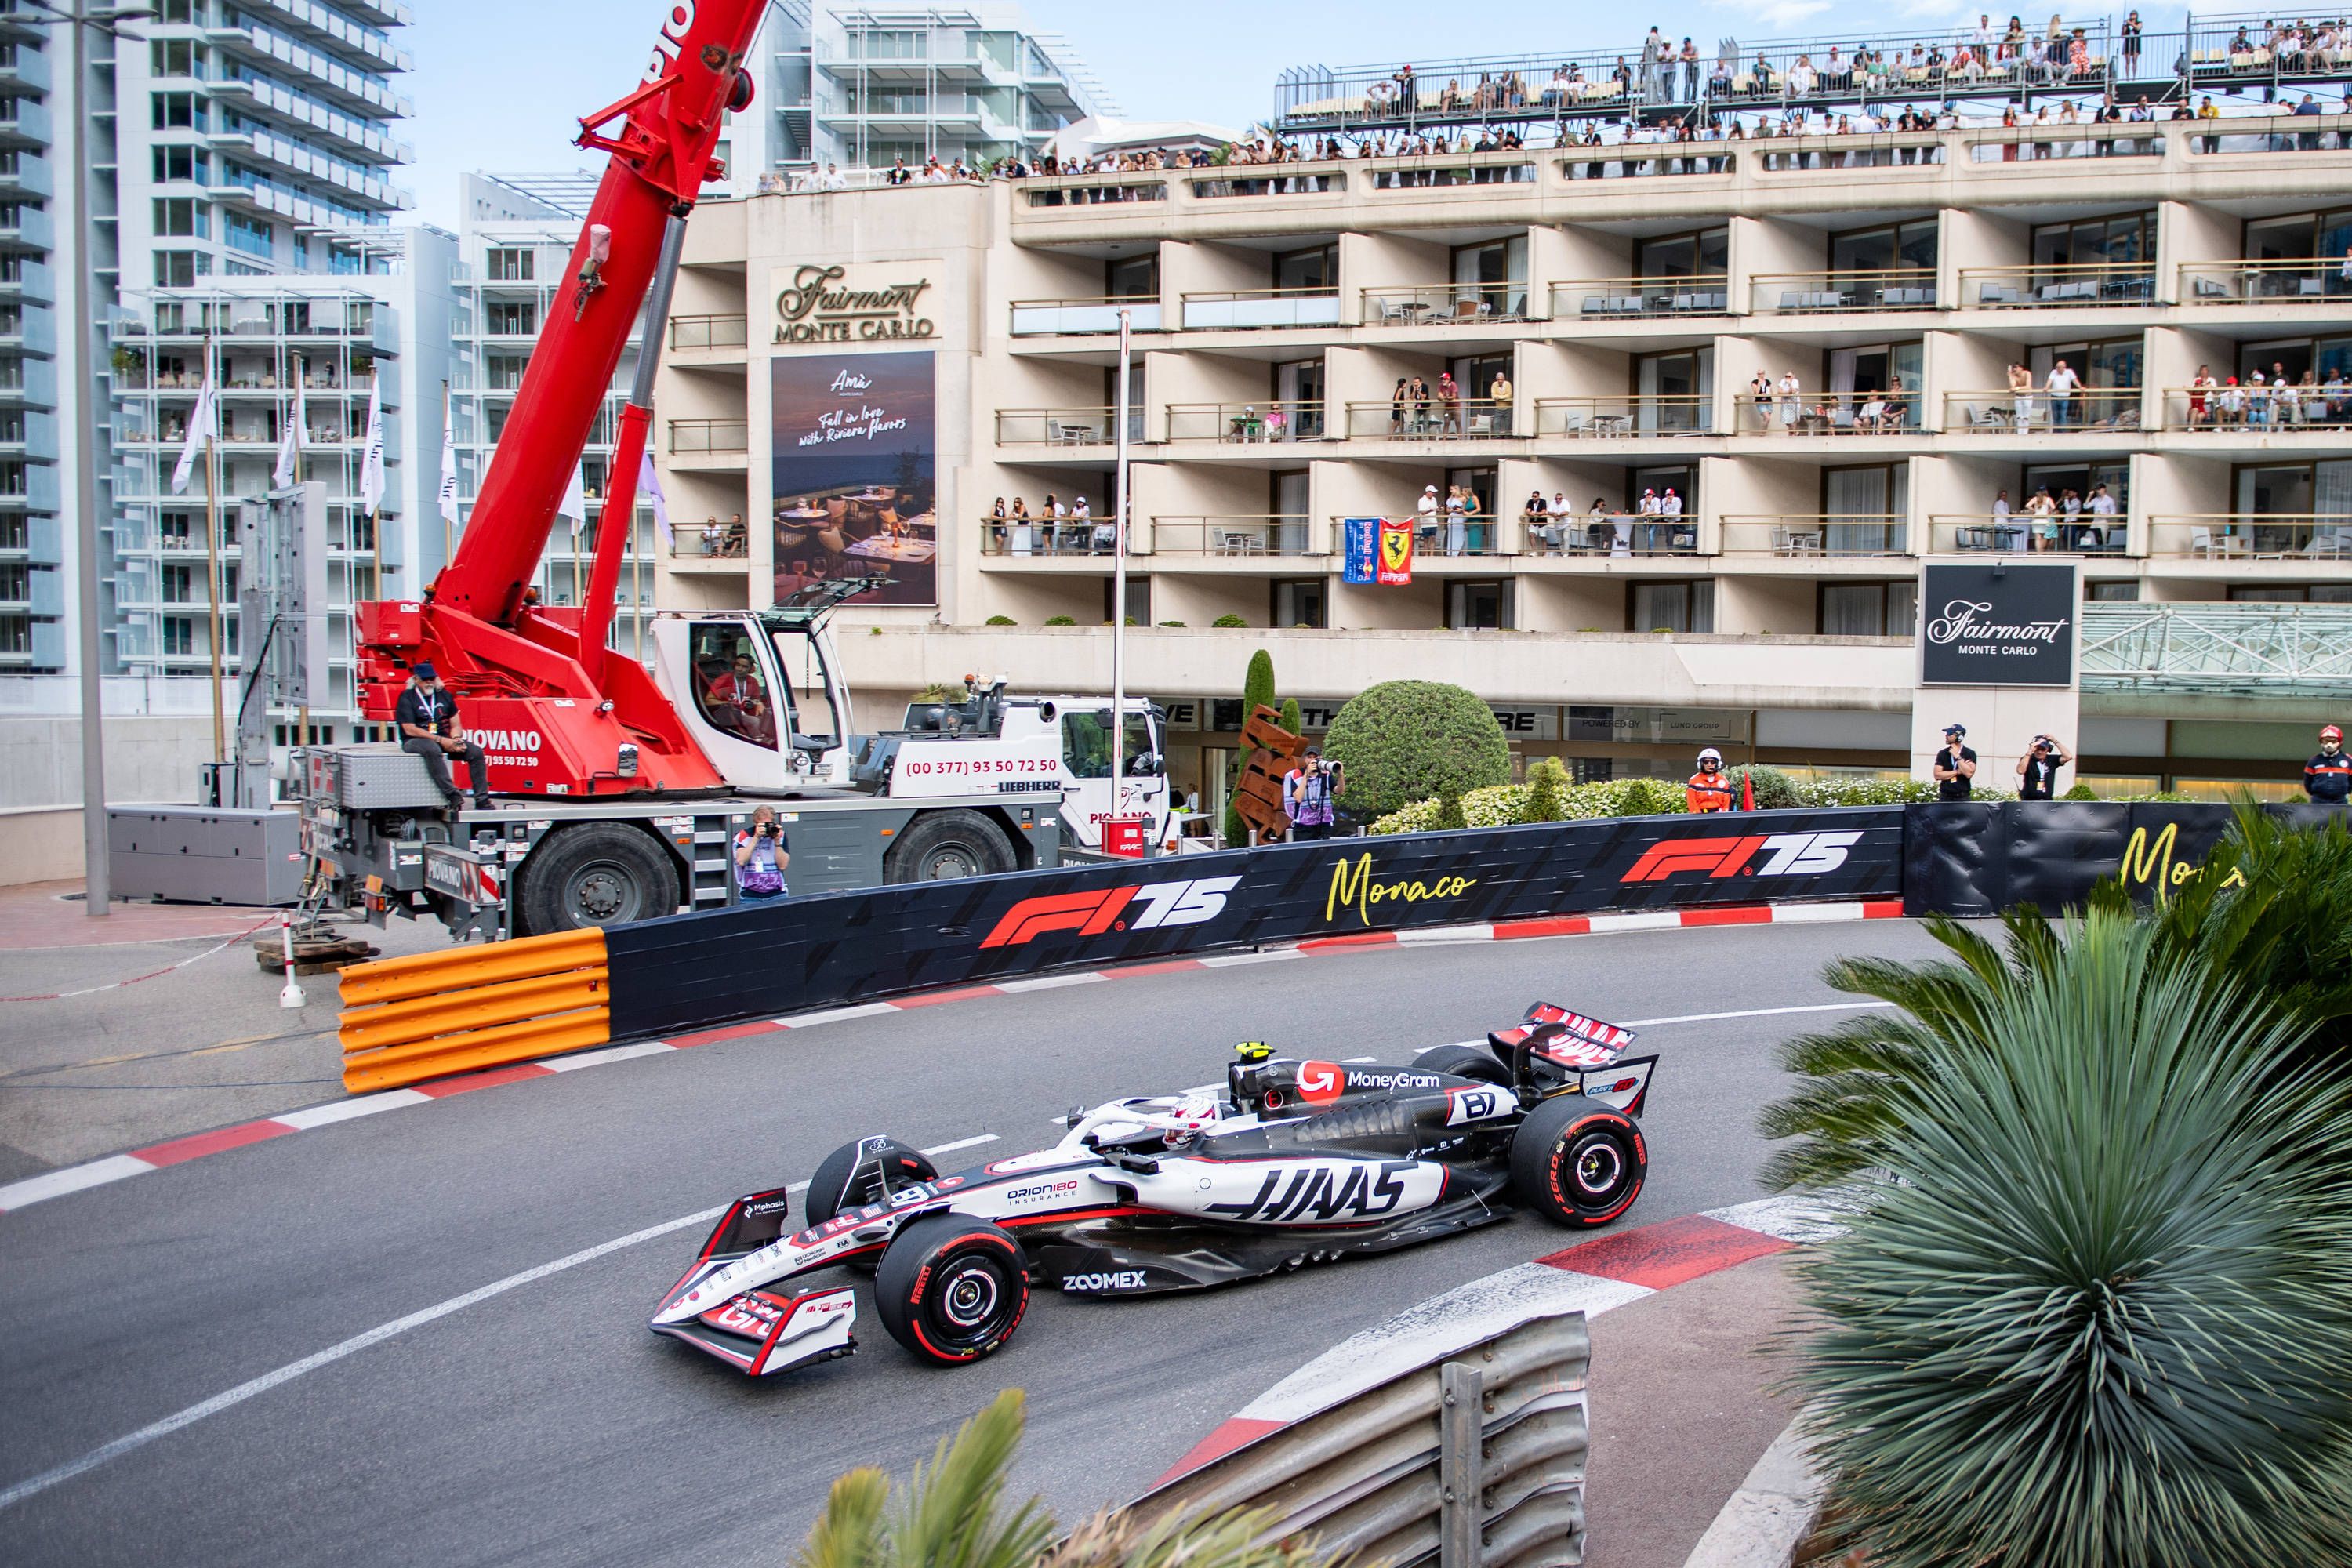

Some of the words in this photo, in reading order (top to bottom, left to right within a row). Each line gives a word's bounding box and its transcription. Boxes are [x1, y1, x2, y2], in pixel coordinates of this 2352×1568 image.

[642, 0, 696, 84] PIO
[776, 264, 931, 321] Fairmont
[774, 321, 851, 342] MONTE
[859, 318, 935, 339] CARLO
[818, 409, 844, 429] Fall
[845, 412, 859, 423] in
[861, 405, 884, 421] love
[798, 430, 824, 446] with
[826, 426, 868, 442] Riviera
[868, 418, 906, 440] flavors
[1927, 600, 2070, 644] Fairmont
[1958, 645, 1997, 655] MONTE
[2001, 645, 2038, 655] CARLO
[1581, 720, 1627, 728] POWERED
[493, 756, 503, 765] 93
[504, 757, 515, 765] 50
[516, 757, 527, 766] 72
[528, 757, 539, 766] 50
[906, 763, 931, 777] (00
[936, 761, 969, 775] 377)
[973, 761, 990, 773] 93
[996, 760, 1014, 771] 50
[1018, 760, 1035, 771] 72
[1040, 760, 1057, 771] 50
[998, 781, 1061, 793] LIEBHERR
[1756, 831, 1864, 876] 75
[428, 858, 460, 887] PIOVANO
[1131, 875, 1243, 930] 75
[1326, 852, 1477, 927] Monaco
[1348, 1071, 1439, 1091] MoneyGram
[1633, 1133, 1646, 1166] PIRELLI
[1007, 1181, 1078, 1199] ORION180
[1203, 1161, 1418, 1221] HAAS
[1550, 1155, 1566, 1204] ZERO
[753, 1200, 785, 1212] Mphasis
[1009, 1191, 1076, 1206] INSURANCE
[836, 1240, 849, 1248] FIA
[910, 1265, 931, 1305] PIRELLI
[1062, 1270, 1147, 1290] ZOOMEX
[1005, 1287, 1029, 1341] ZERO
